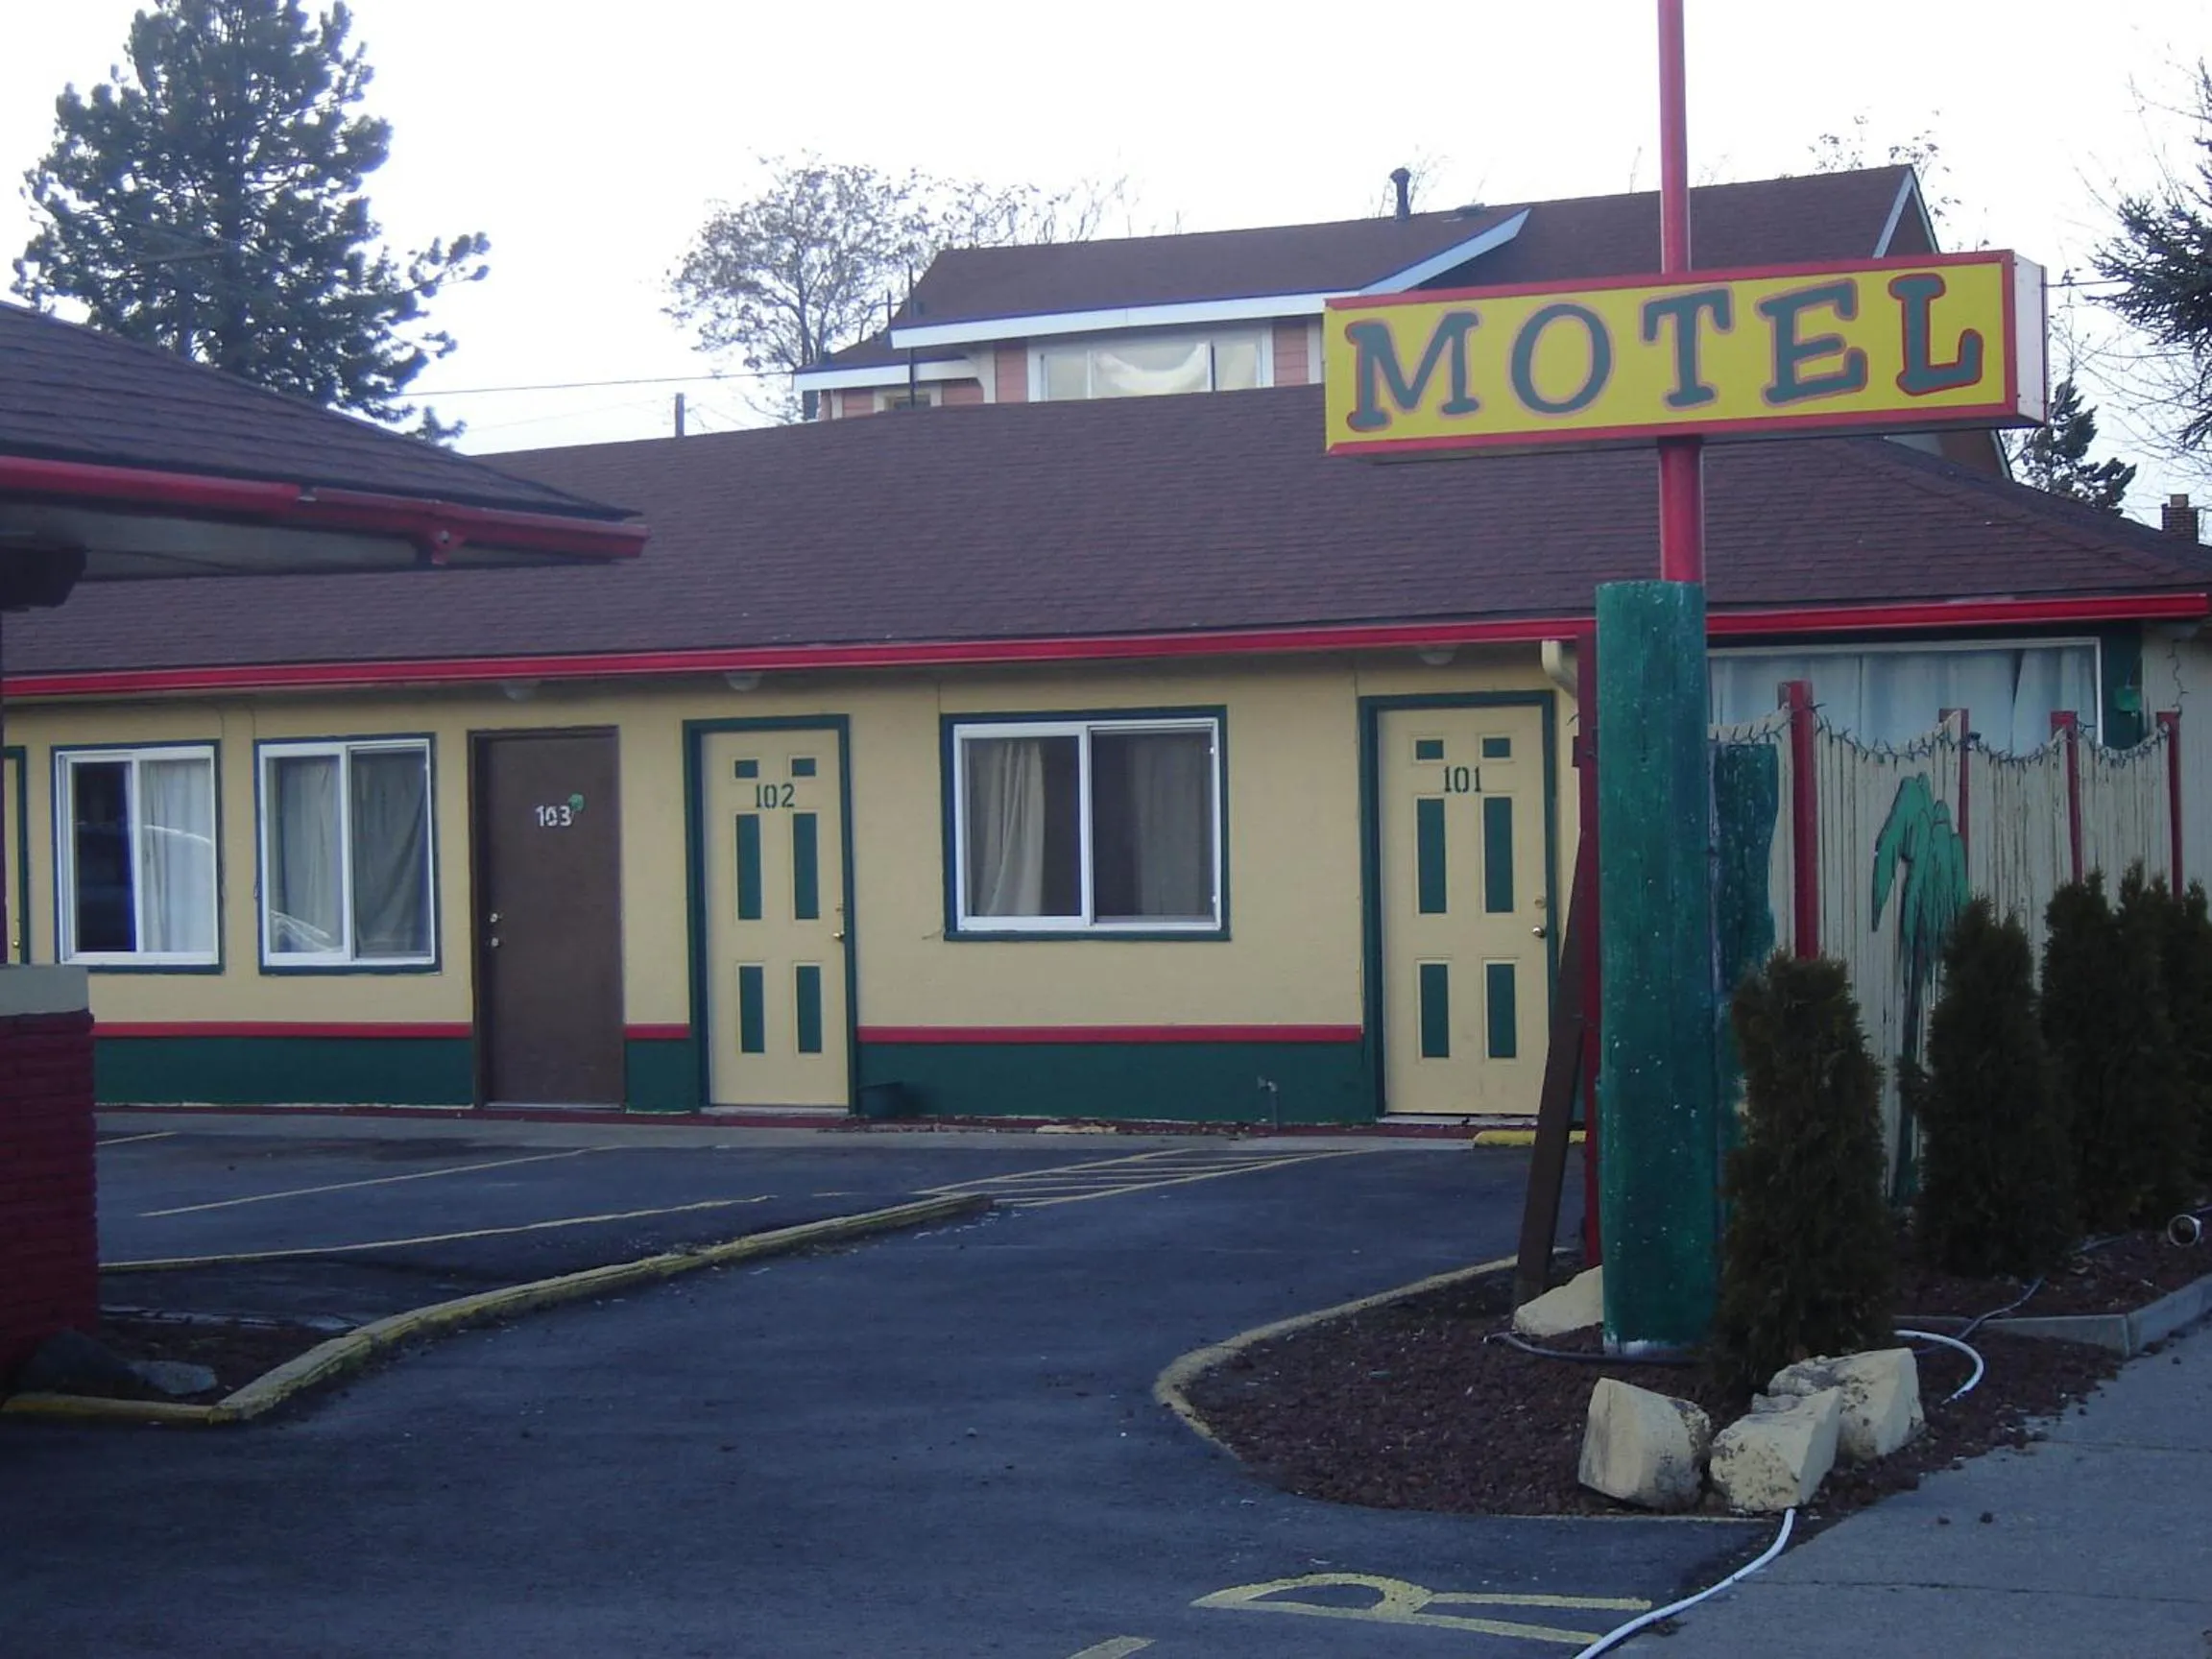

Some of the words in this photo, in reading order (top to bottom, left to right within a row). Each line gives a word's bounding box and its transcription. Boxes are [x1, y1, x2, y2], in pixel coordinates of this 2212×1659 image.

[1345, 272, 1984, 433] MOTEL
[1444, 766, 1481, 793] 101
[756, 782, 795, 809] 102
[536, 805, 572, 827] 103
